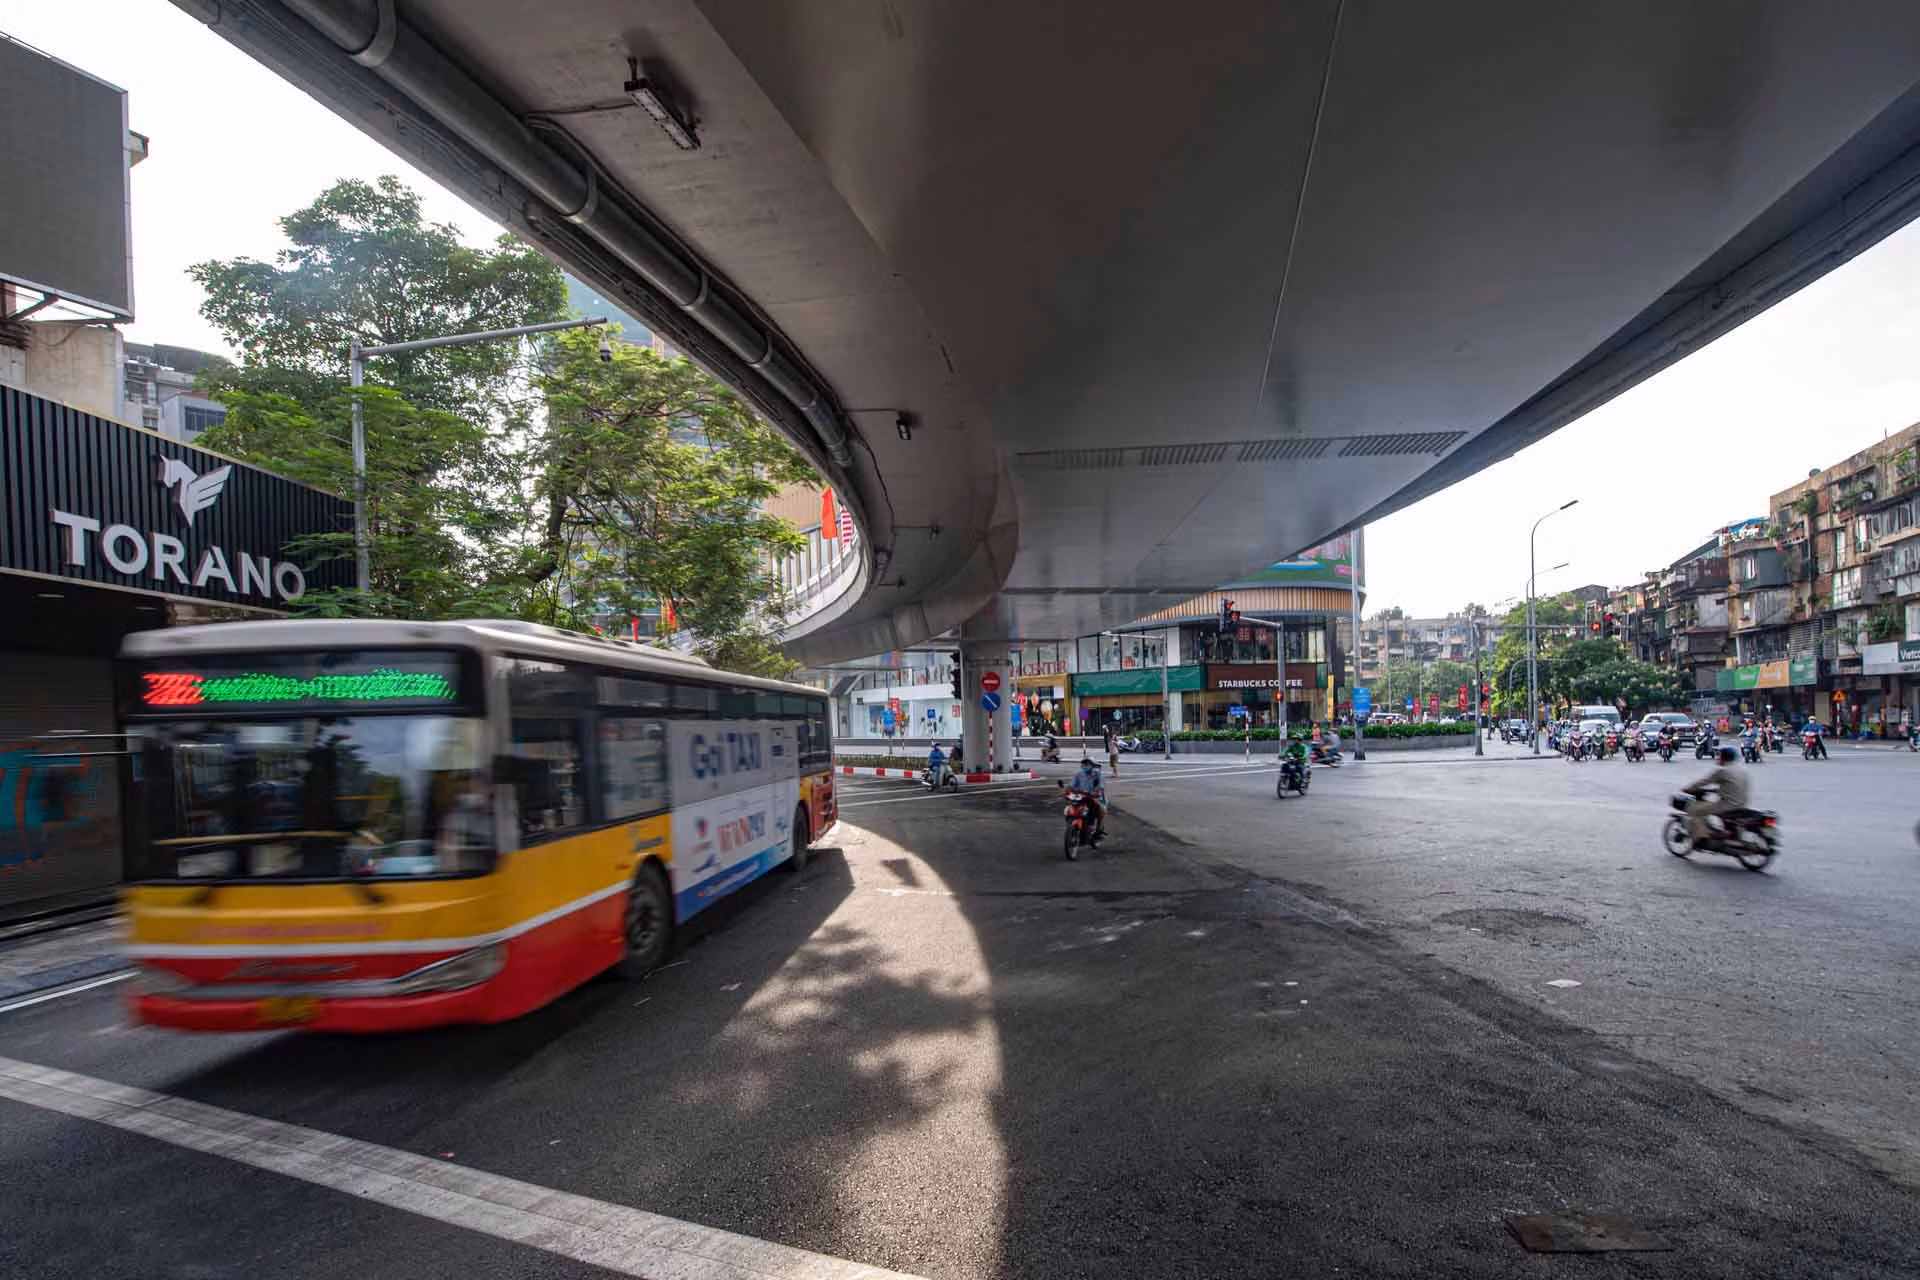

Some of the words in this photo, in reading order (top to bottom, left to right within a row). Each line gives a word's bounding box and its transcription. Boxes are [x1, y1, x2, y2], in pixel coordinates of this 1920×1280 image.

[50, 508, 306, 601] TORANO
[1218, 679, 1267, 688] STARBUCKS
[1267, 679, 1303, 687] COFEE
